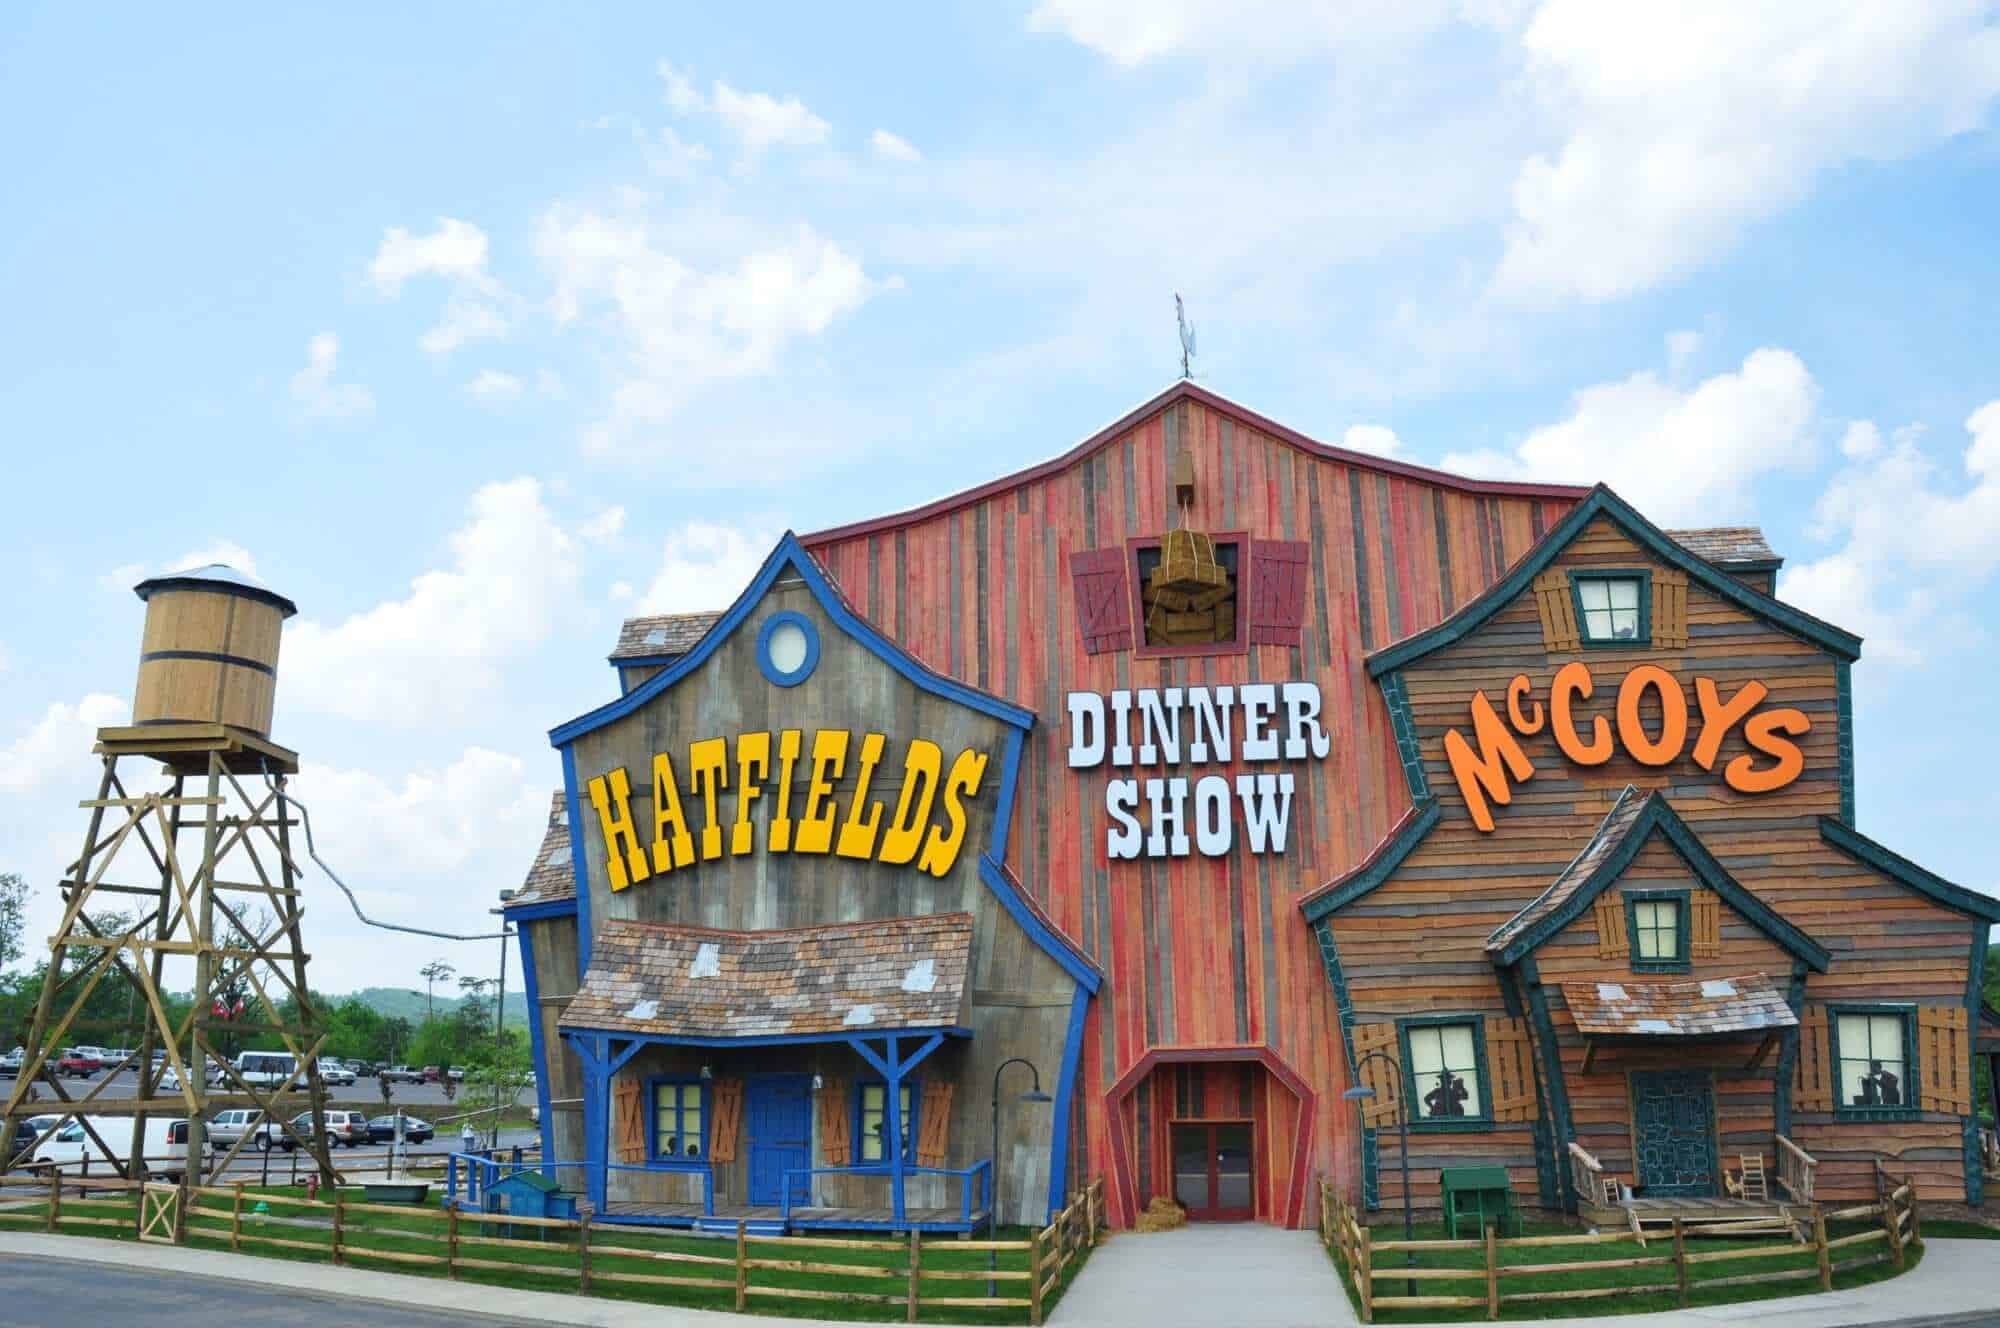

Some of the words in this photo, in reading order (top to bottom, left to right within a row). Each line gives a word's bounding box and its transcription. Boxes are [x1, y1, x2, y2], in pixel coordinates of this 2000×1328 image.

[1067, 682, 1331, 769] DINNER
[588, 728, 987, 892] HATFIELDS
[1105, 773, 1297, 860] SHOW
